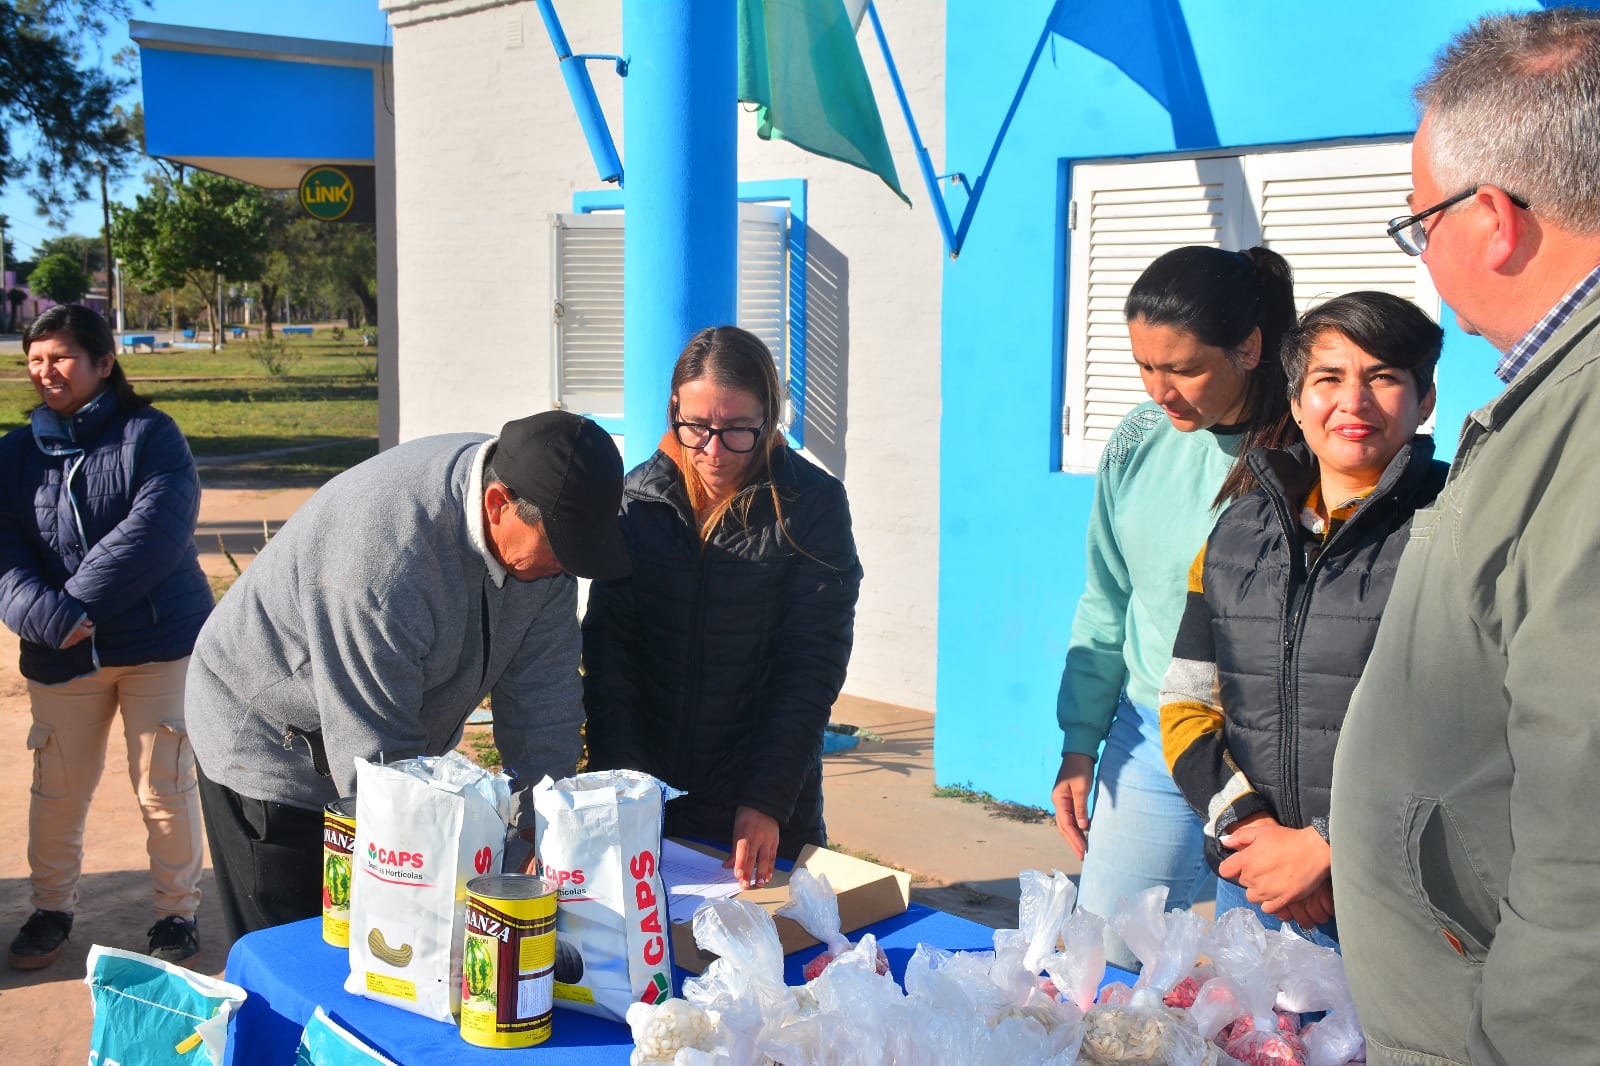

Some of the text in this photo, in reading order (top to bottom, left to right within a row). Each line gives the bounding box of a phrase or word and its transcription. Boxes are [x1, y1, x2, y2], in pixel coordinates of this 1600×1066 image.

[324, 828, 354, 852] NANZ
[378, 848, 424, 869] CAPS
[545, 865, 585, 886] CAPS
[630, 850, 664, 966] CAPS
